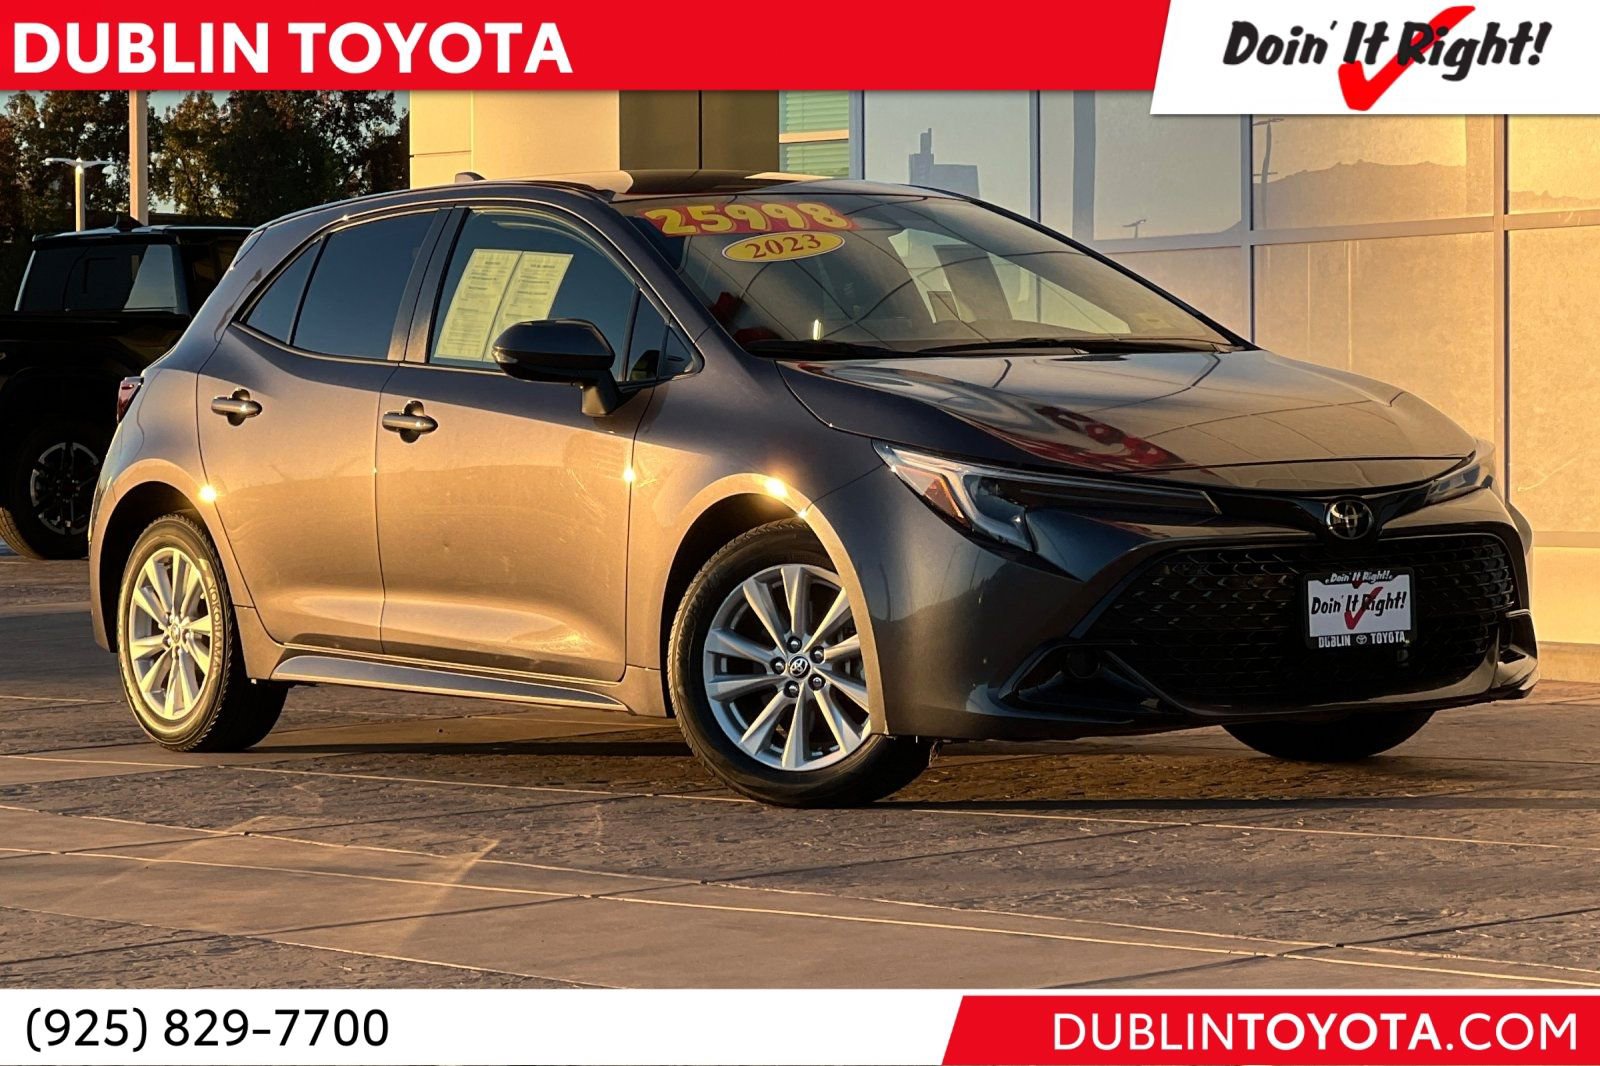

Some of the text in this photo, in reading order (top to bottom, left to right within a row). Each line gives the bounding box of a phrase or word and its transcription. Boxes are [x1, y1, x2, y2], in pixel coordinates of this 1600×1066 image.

[645, 203, 850, 234] 25998
[745, 234, 821, 259] 2023
[1352, 571, 1361, 581] It
[1311, 591, 1407, 616] Doin' It Right!
[209, 584, 222, 669] YOKOHAMA
[1318, 631, 1405, 648] DUBLIN TOYOTA
